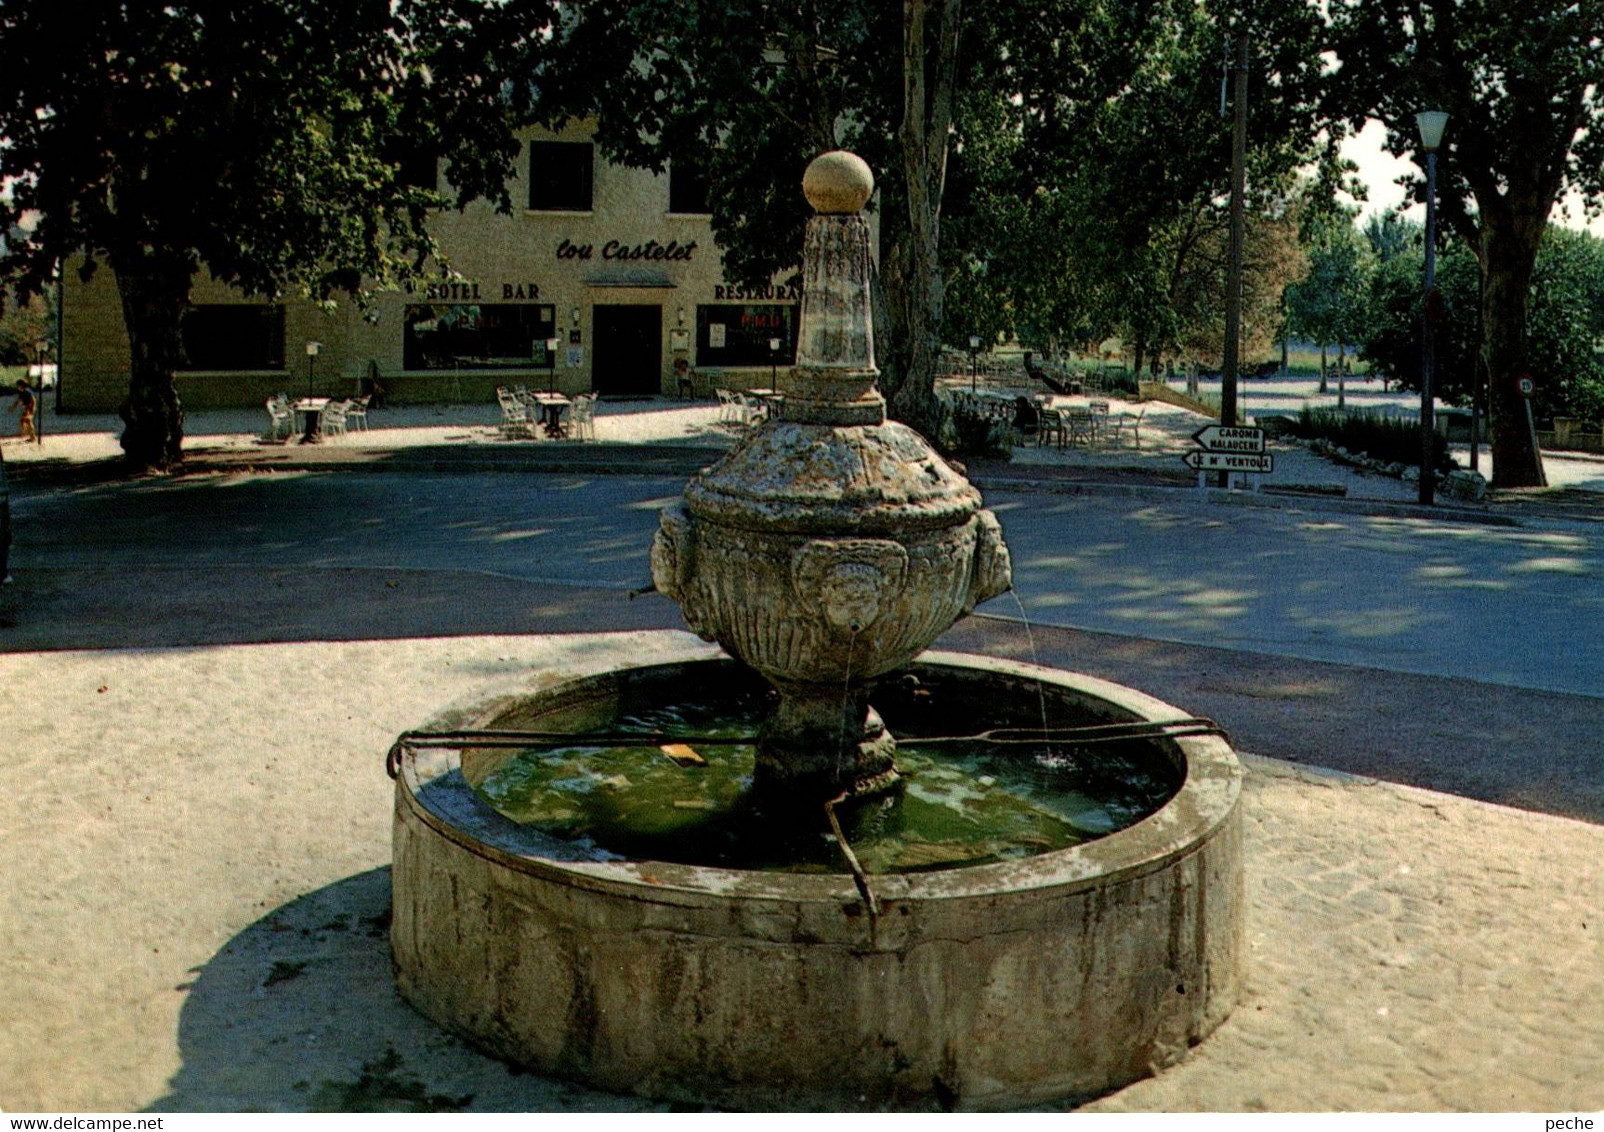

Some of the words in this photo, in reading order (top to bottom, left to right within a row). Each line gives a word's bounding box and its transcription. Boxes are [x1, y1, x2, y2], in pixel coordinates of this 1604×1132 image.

[602, 239, 698, 261] Castelet
[502, 283, 540, 300] BAR
[1218, 428, 1260, 439] CAROMB
[1225, 457, 1270, 468] VENTOUX
